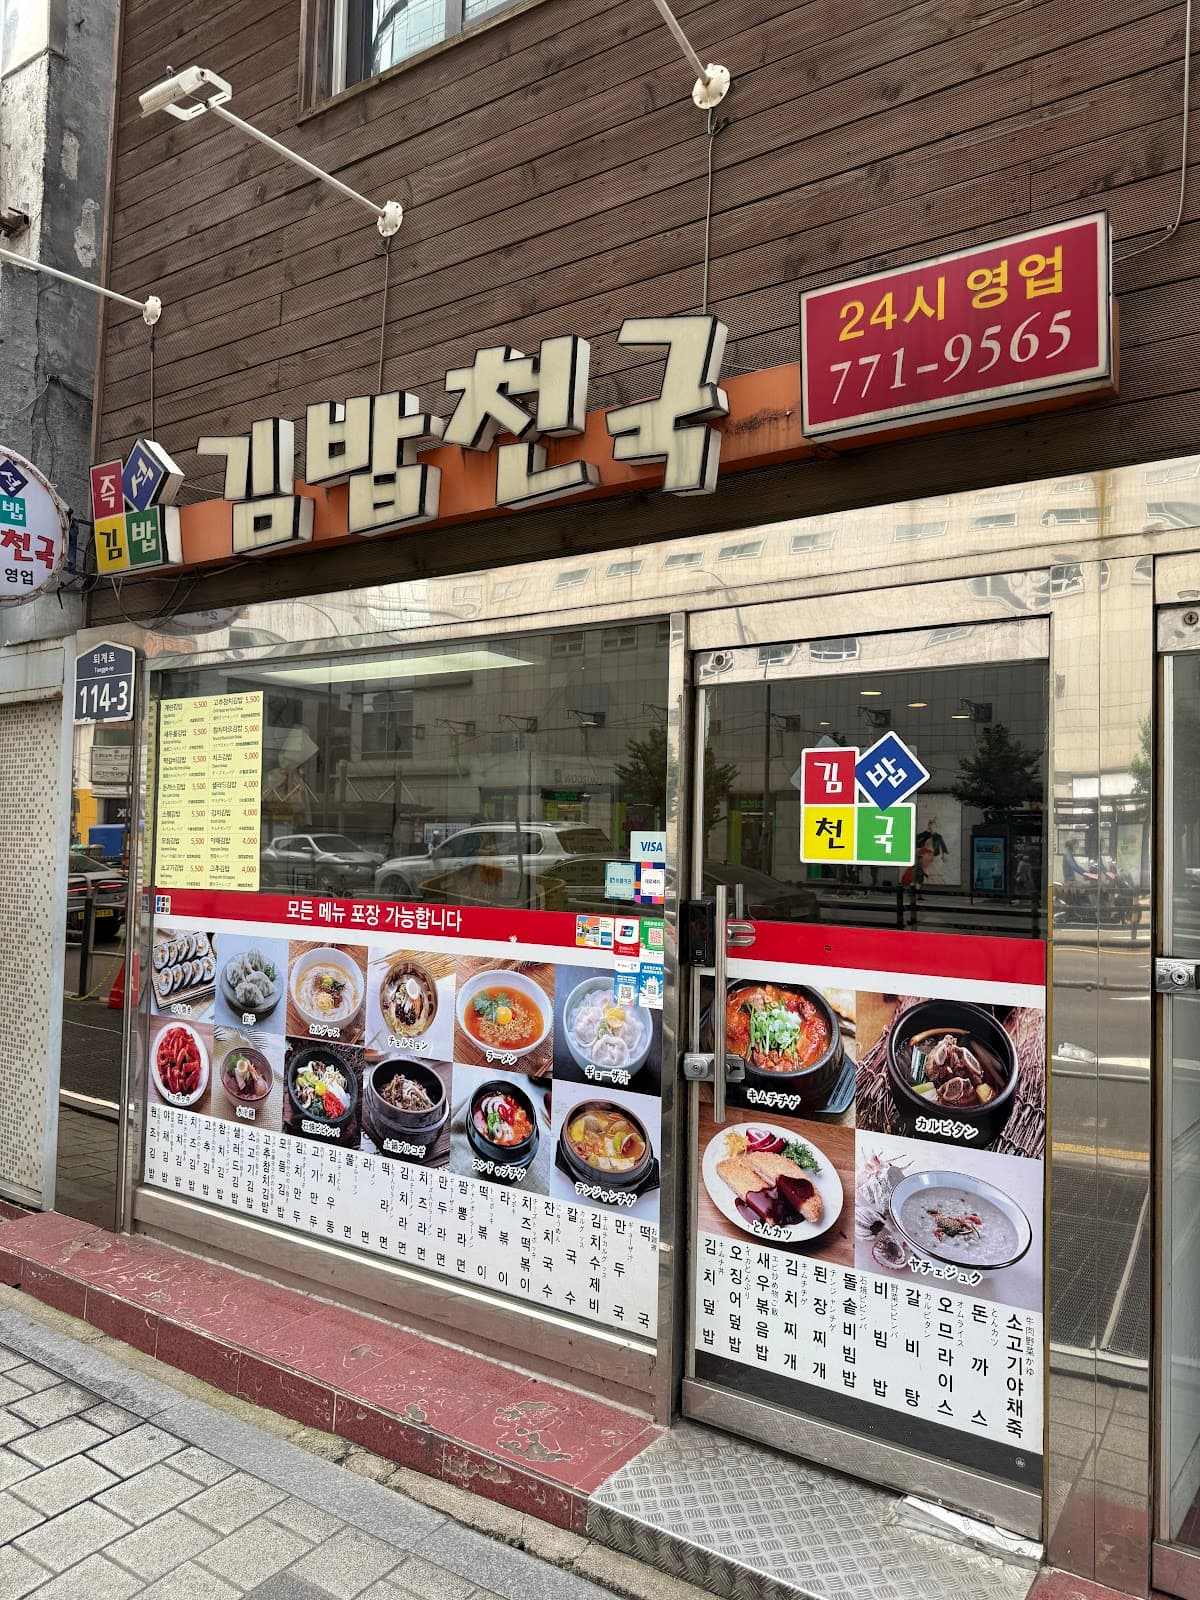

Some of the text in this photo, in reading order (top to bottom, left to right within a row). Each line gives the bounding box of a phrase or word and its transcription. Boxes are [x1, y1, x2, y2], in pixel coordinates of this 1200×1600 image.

[838, 245, 1065, 342] 24시 영업
[829, 309, 1074, 405] 771-9565
[197, 314, 730, 556] 김밥천국
[5, 567, 33, 585] 영업
[80, 680, 128, 714] 114-3
[92, 651, 116, 665] 퇴계로
[640, 841, 663, 852] VISA
[286, 900, 463, 933] 모든 메뉴 포장 가능합니다
[486, 1051, 517, 1065] ラーメン
[585, 1065, 630, 1084] ギョーザ汁
[747, 1088, 801, 1110] キムチチゲ
[175, 1113, 184, 1187] 김치김밥
[188, 1116, 198, 1192] 치즈김밥
[202, 1120, 212, 1196] 고추김밥
[216, 1123, 226, 1200] 참치김밥
[231, 1127, 241, 1205] 샐러드김밥
[246, 1131, 256, 1209] 소고기김밥
[914, 1115, 980, 1140] カルビタン
[261, 1135, 271, 1214] 고추참치김밥
[292, 1141, 303, 1223] 김치만두
[309, 1146, 319, 1228] 고기만두
[326, 1149, 337, 1234] 김치우동
[361, 1158, 372, 1244] 라면
[379, 1162, 390, 1250] 떡라면
[398, 1166, 409, 1255] 김치라면
[416, 1171, 428, 1261] 치즈라면
[575, 1182, 636, 1207] テンジャンチゲ
[436, 1175, 448, 1267] 만두라면
[456, 1180, 468, 1273] 짬뽕라면
[477, 1185, 489, 1280] 떡볶이
[498, 1191, 510, 1286] 라볶이
[520, 1196, 532, 1293] 치즈떡볶이
[542, 1201, 555, 1298] 잔치국수
[564, 1207, 578, 1306] 칼국수
[589, 1213, 601, 1314] 김치수제비
[752, 1221, 793, 1240] とんカツ
[612, 1219, 627, 1321] 만두국
[638, 1225, 651, 1329] 떡국
[703, 1238, 716, 1346] 김치덮밥
[729, 1245, 743, 1354] 오징어덮밥
[755, 1252, 770, 1361] 새우볶음밥
[908, 1258, 982, 1285] ヤチェジュク
[783, 1259, 798, 1371] 김치찌개
[812, 1266, 828, 1380] 된장찌개
[842, 1273, 858, 1388] 돌솥비빔밥
[873, 1281, 888, 1398] 비빔밥
[905, 1288, 921, 1407] 갈비탕
[937, 1297, 954, 1417] 오므라이스
[971, 1304, 989, 1427] 돈까스
[1006, 1313, 1024, 1439] 소고기야채죽
